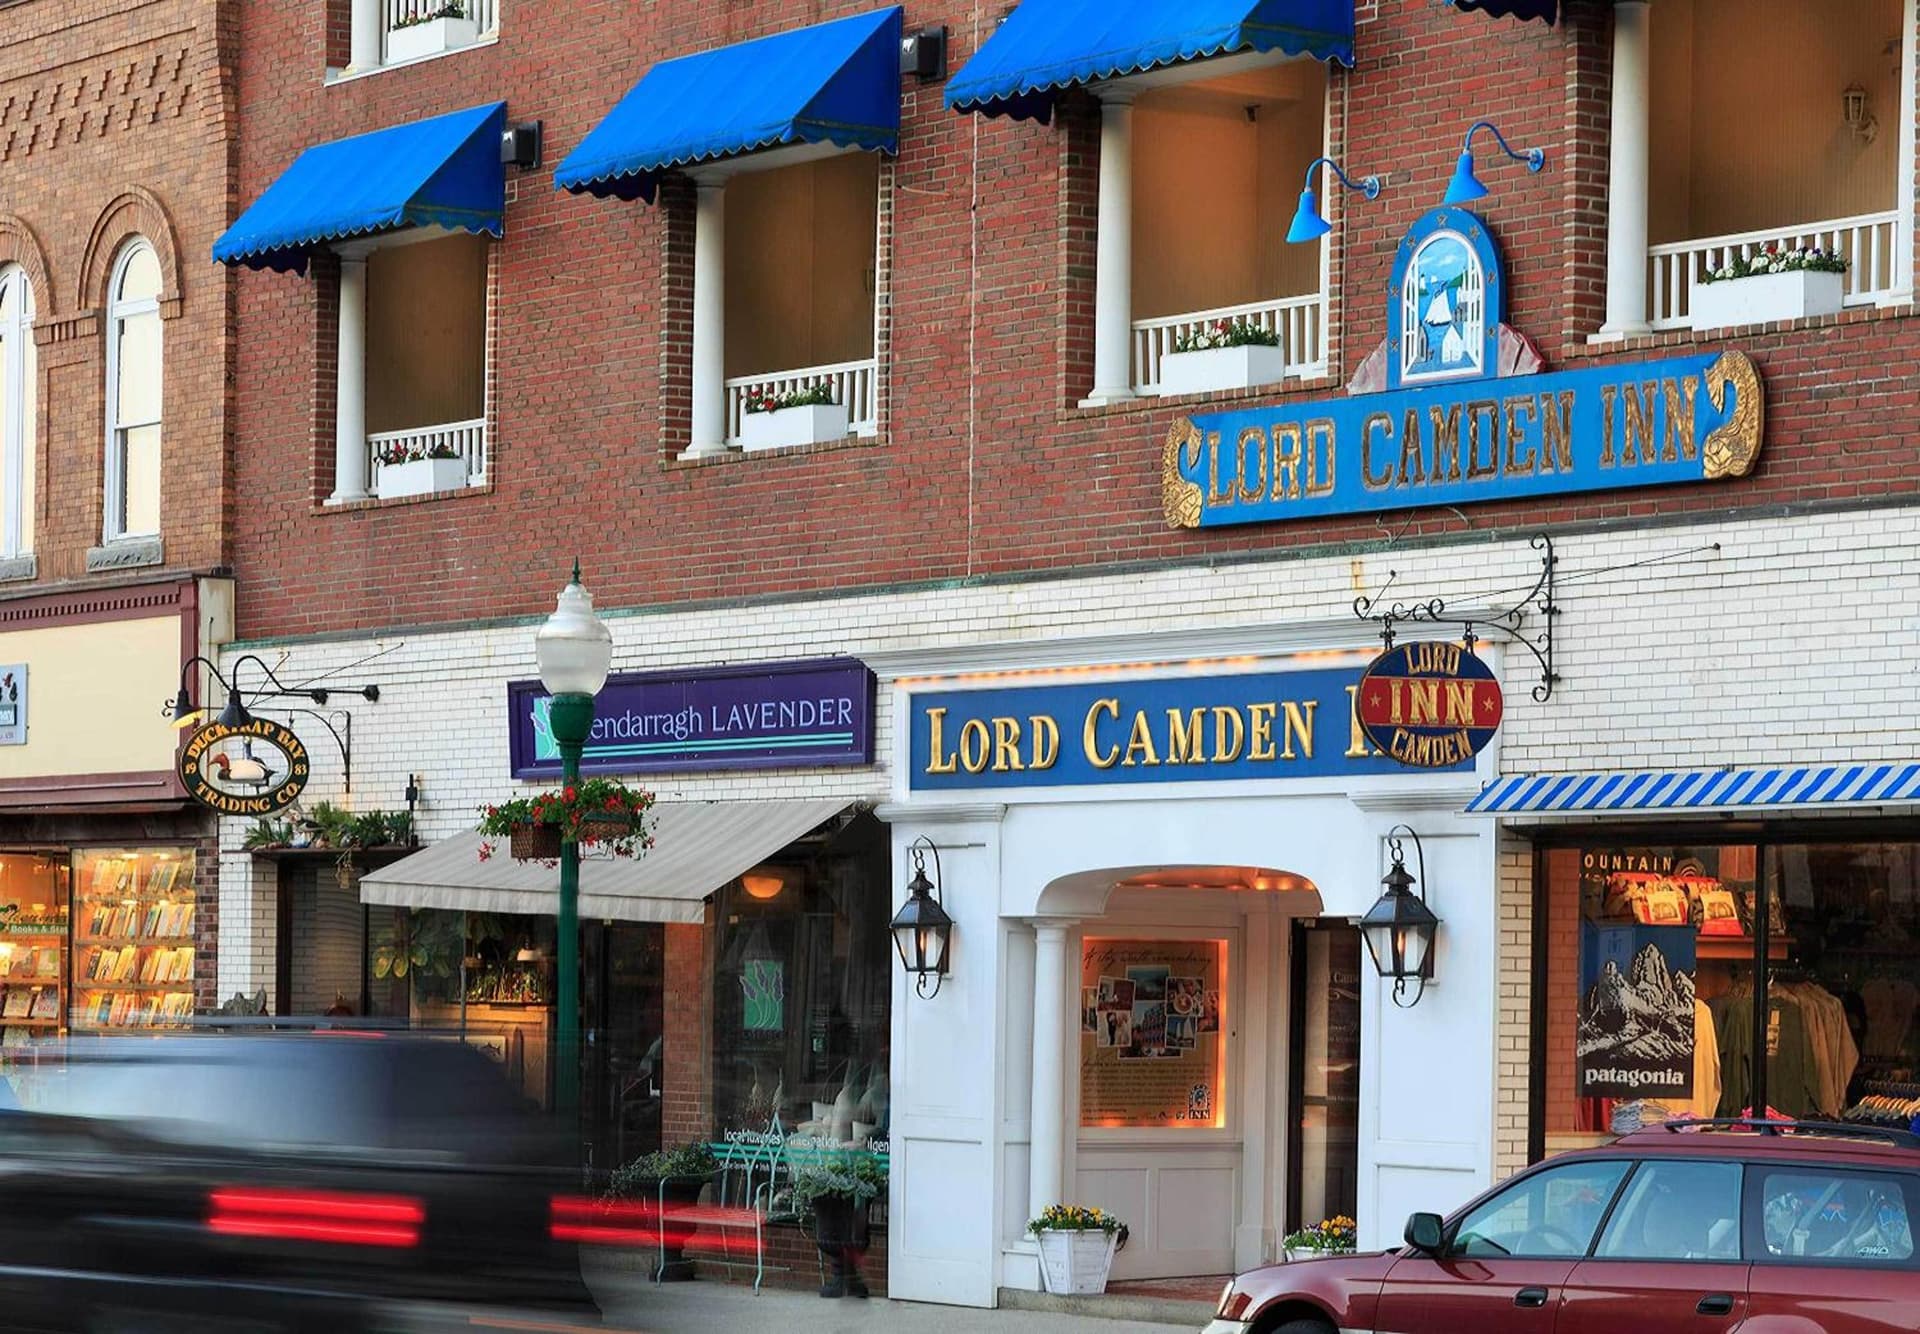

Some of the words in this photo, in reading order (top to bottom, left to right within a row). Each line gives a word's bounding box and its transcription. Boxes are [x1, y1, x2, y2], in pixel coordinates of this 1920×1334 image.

[1207, 416, 1336, 506] LORD
[1361, 391, 1575, 489] CAMDEN
[1599, 374, 1700, 469] INN
[1403, 642, 1461, 676] LORD
[590, 705, 703, 741] endarragh
[712, 698, 853, 732] LAVENDER
[1389, 679, 1476, 726] INN
[276, 730, 305, 760] BAY
[1390, 727, 1473, 767] CAMDEN
[293, 763, 307, 776] 83
[194, 782, 272, 813] TRADING
[1584, 1066, 1685, 1088] patagonia
